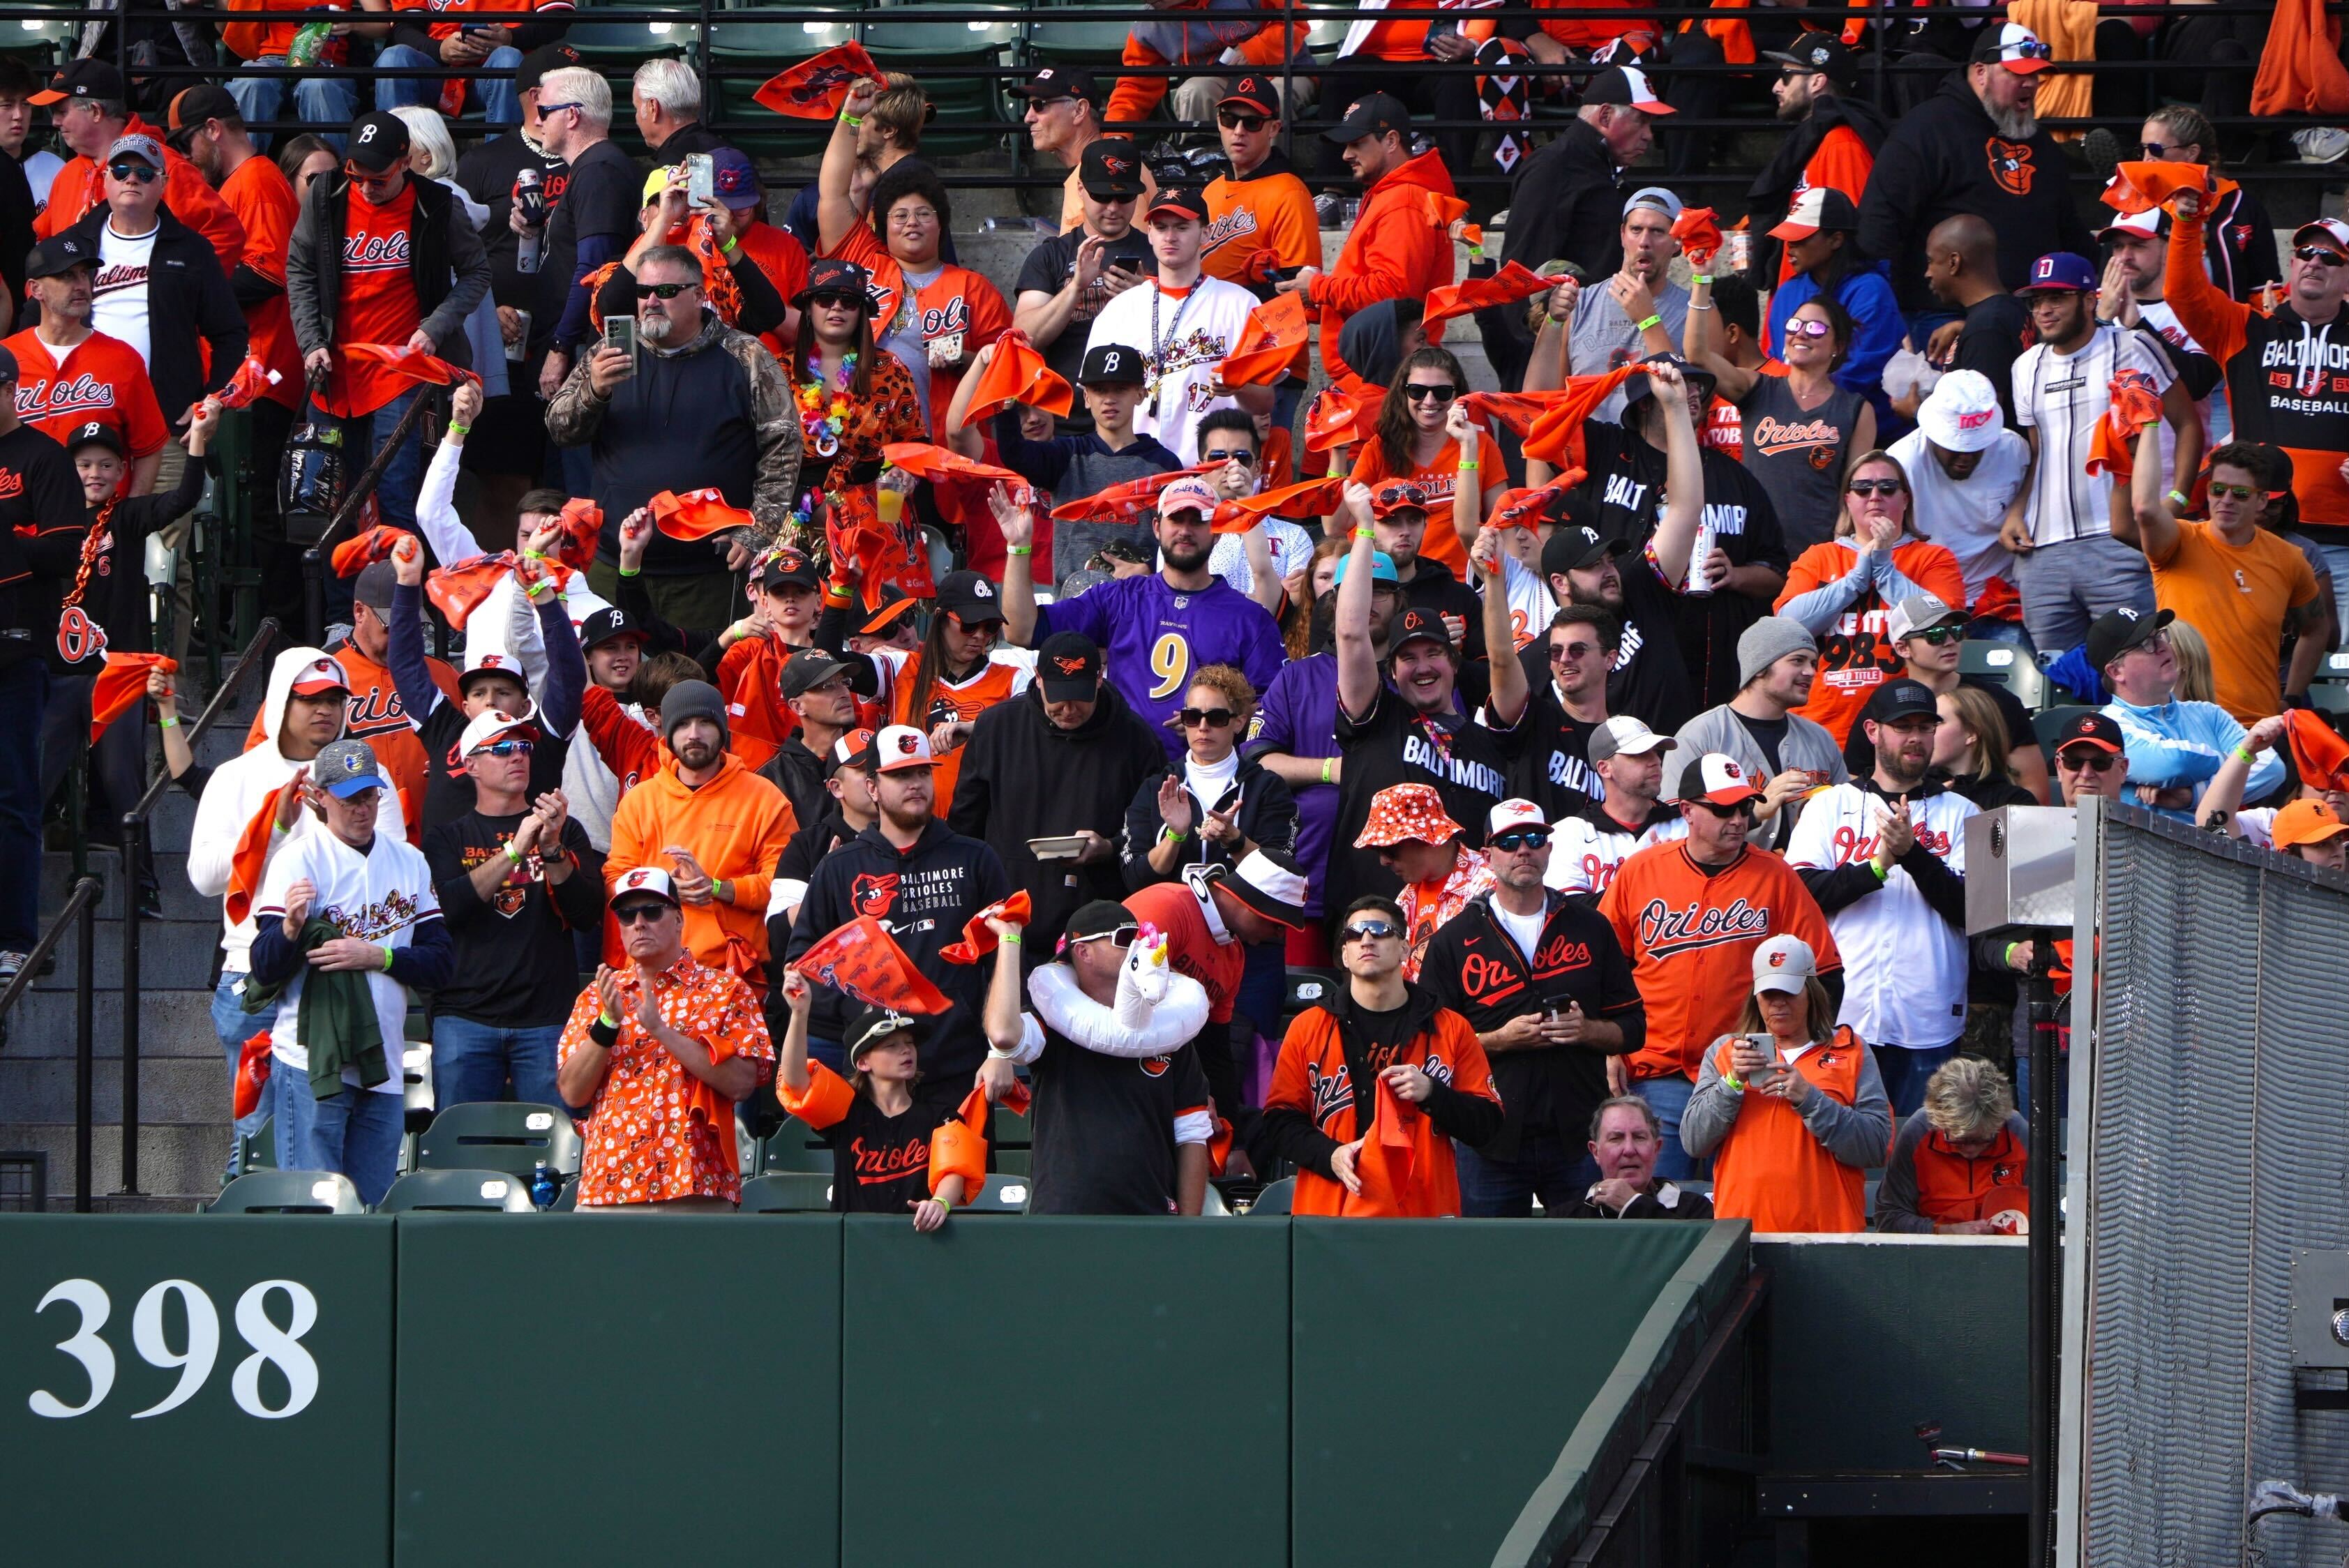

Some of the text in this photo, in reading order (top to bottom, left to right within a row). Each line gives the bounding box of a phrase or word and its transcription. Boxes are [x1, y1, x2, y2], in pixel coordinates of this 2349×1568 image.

[358, 124, 377, 144] B
[1209, 206, 1256, 241] ioles
[1104, 352, 1120, 374] B
[15, 374, 113, 414] rioles
[83, 421, 100, 439] B
[1753, 416, 1840, 457] Orioles
[1581, 526, 1599, 545] B
[98, 555, 110, 576] 6
[609, 610, 624, 628] B
[1404, 612, 1424, 630] O's
[2118, 608, 2139, 621] B
[57, 606, 108, 664] O's
[1149, 633, 1190, 700] 9
[1854, 670, 1879, 681] TITLE
[900, 867, 965, 885] BALTIMORE
[901, 895, 963, 914] BASEBALL
[1639, 898, 1771, 960] Orioles
[1305, 985, 1314, 997] 6
[850, 1136, 931, 1189] Oriole
[29, 1278, 320, 1419] 398
